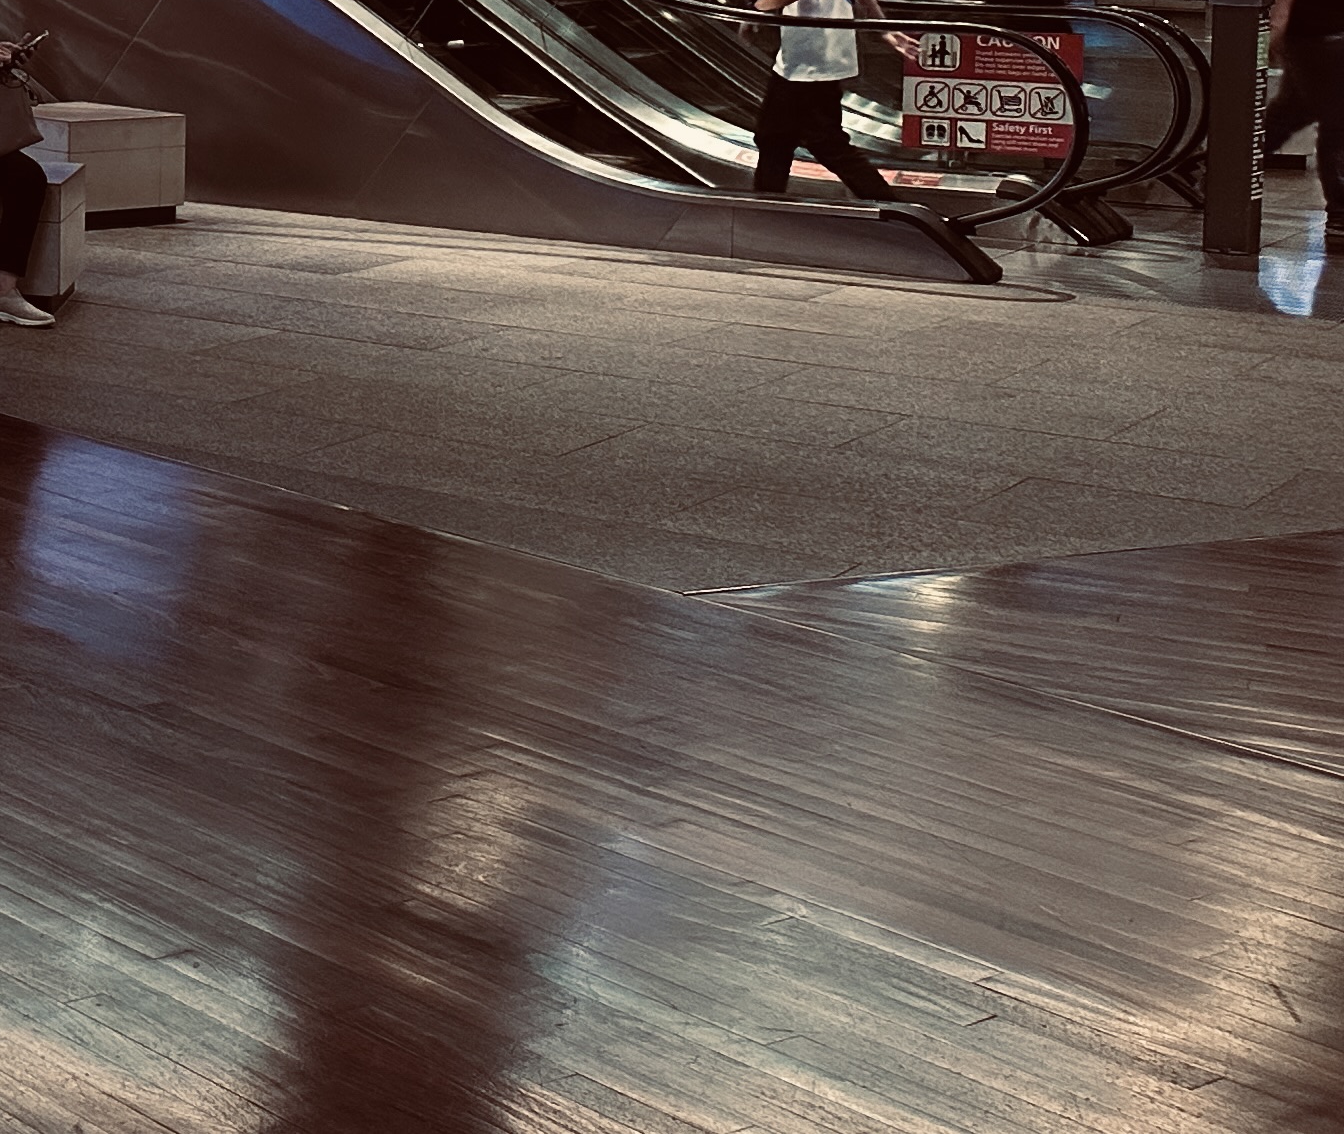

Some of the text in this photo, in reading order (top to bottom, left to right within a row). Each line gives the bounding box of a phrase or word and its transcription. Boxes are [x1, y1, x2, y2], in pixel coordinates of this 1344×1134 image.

[976, 33, 1061, 51] CAUON
[991, 122, 1053, 135] Safety First
